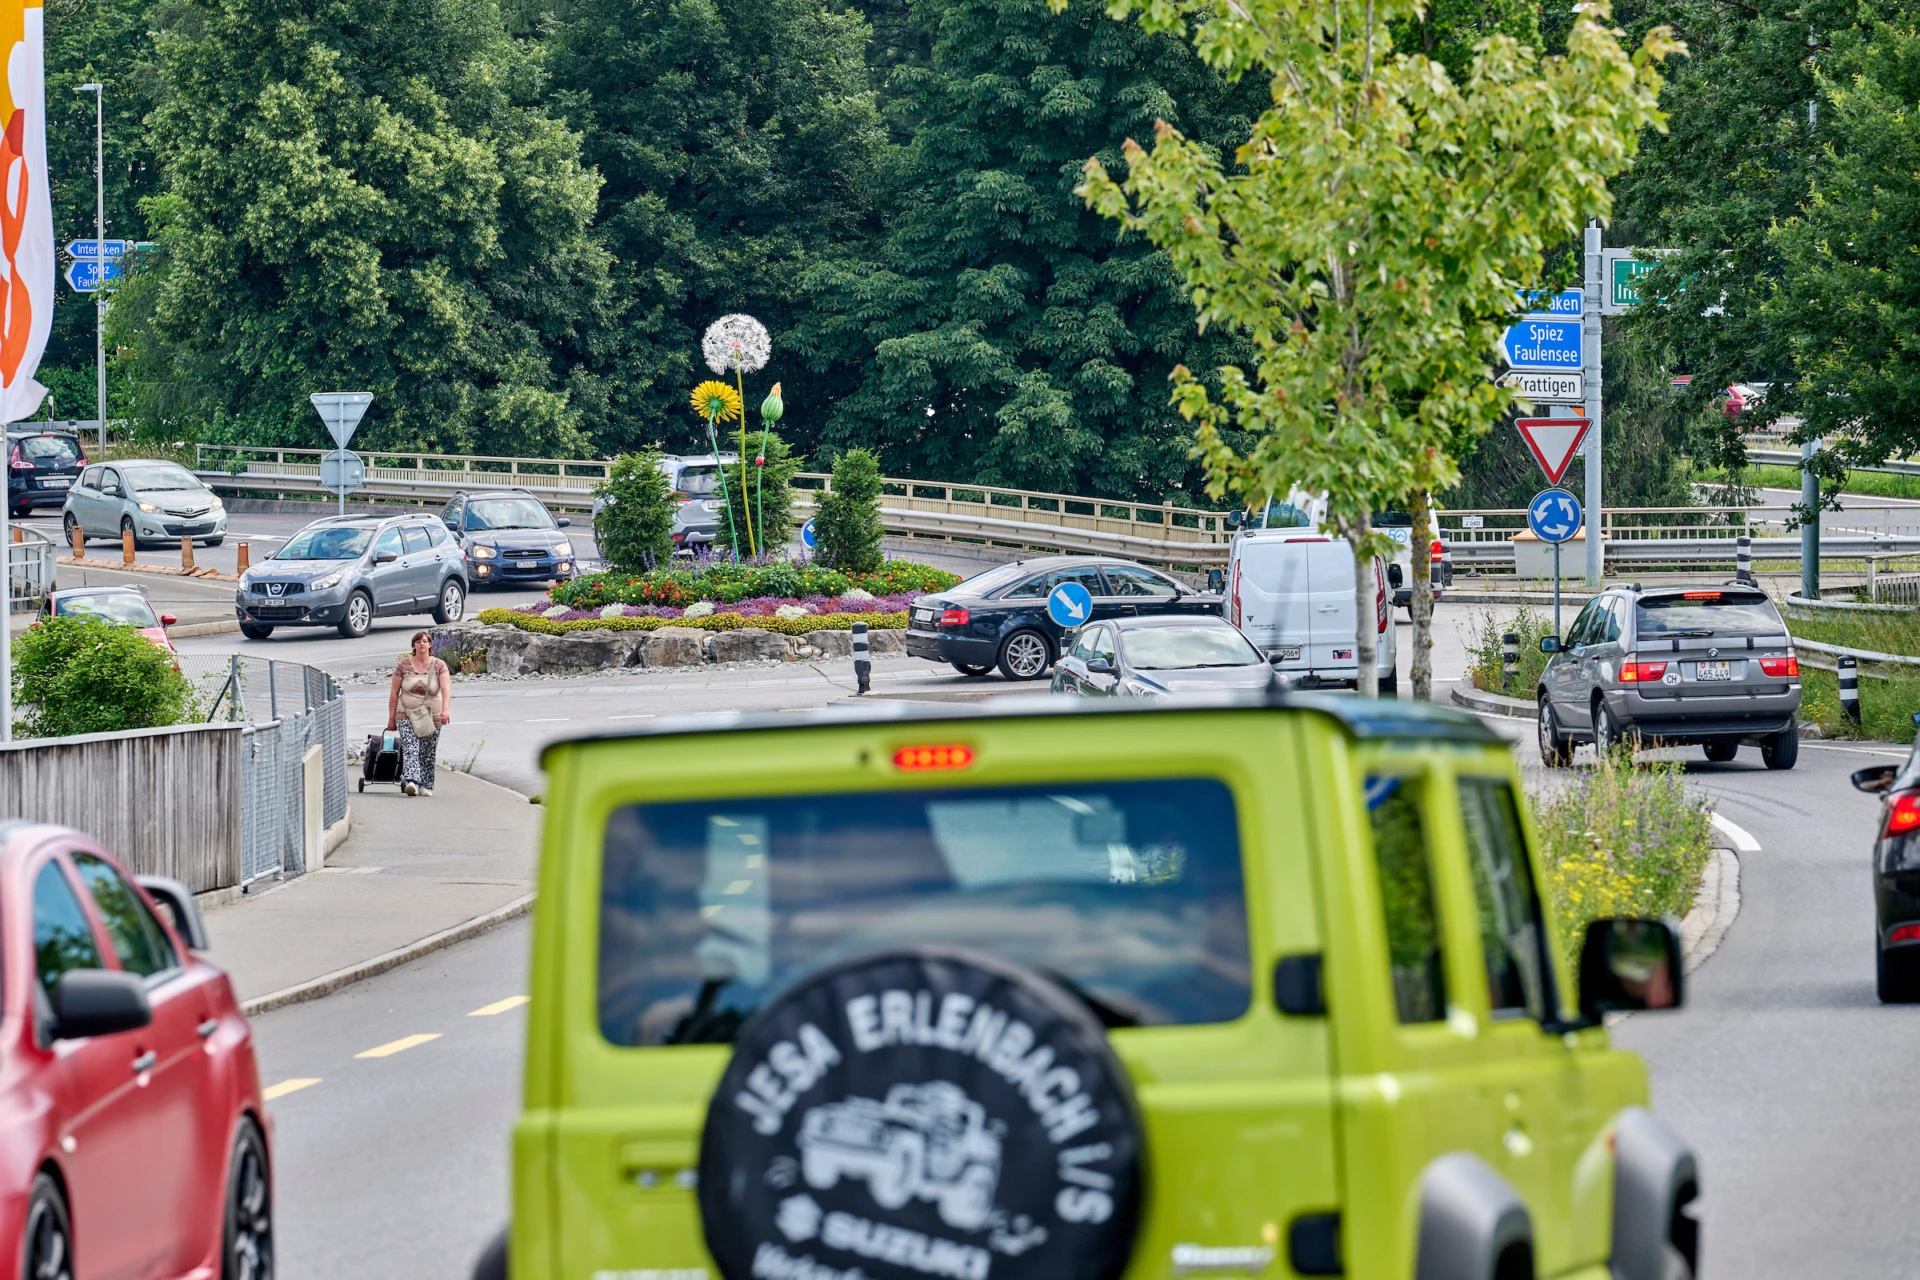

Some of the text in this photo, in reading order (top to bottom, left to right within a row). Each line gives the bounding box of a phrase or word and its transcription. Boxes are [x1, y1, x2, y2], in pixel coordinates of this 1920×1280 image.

[77, 243, 120, 254] Interken
[87, 263, 110, 277] Spz
[1529, 324, 1564, 345] Spiez
[1514, 344, 1578, 362] Faulensee
[1709, 661, 1718, 669] BE
[1666, 674, 1677, 684] CH
[734, 1021, 842, 1137] JESA
[845, 988, 1101, 1145] ERLENBACH
